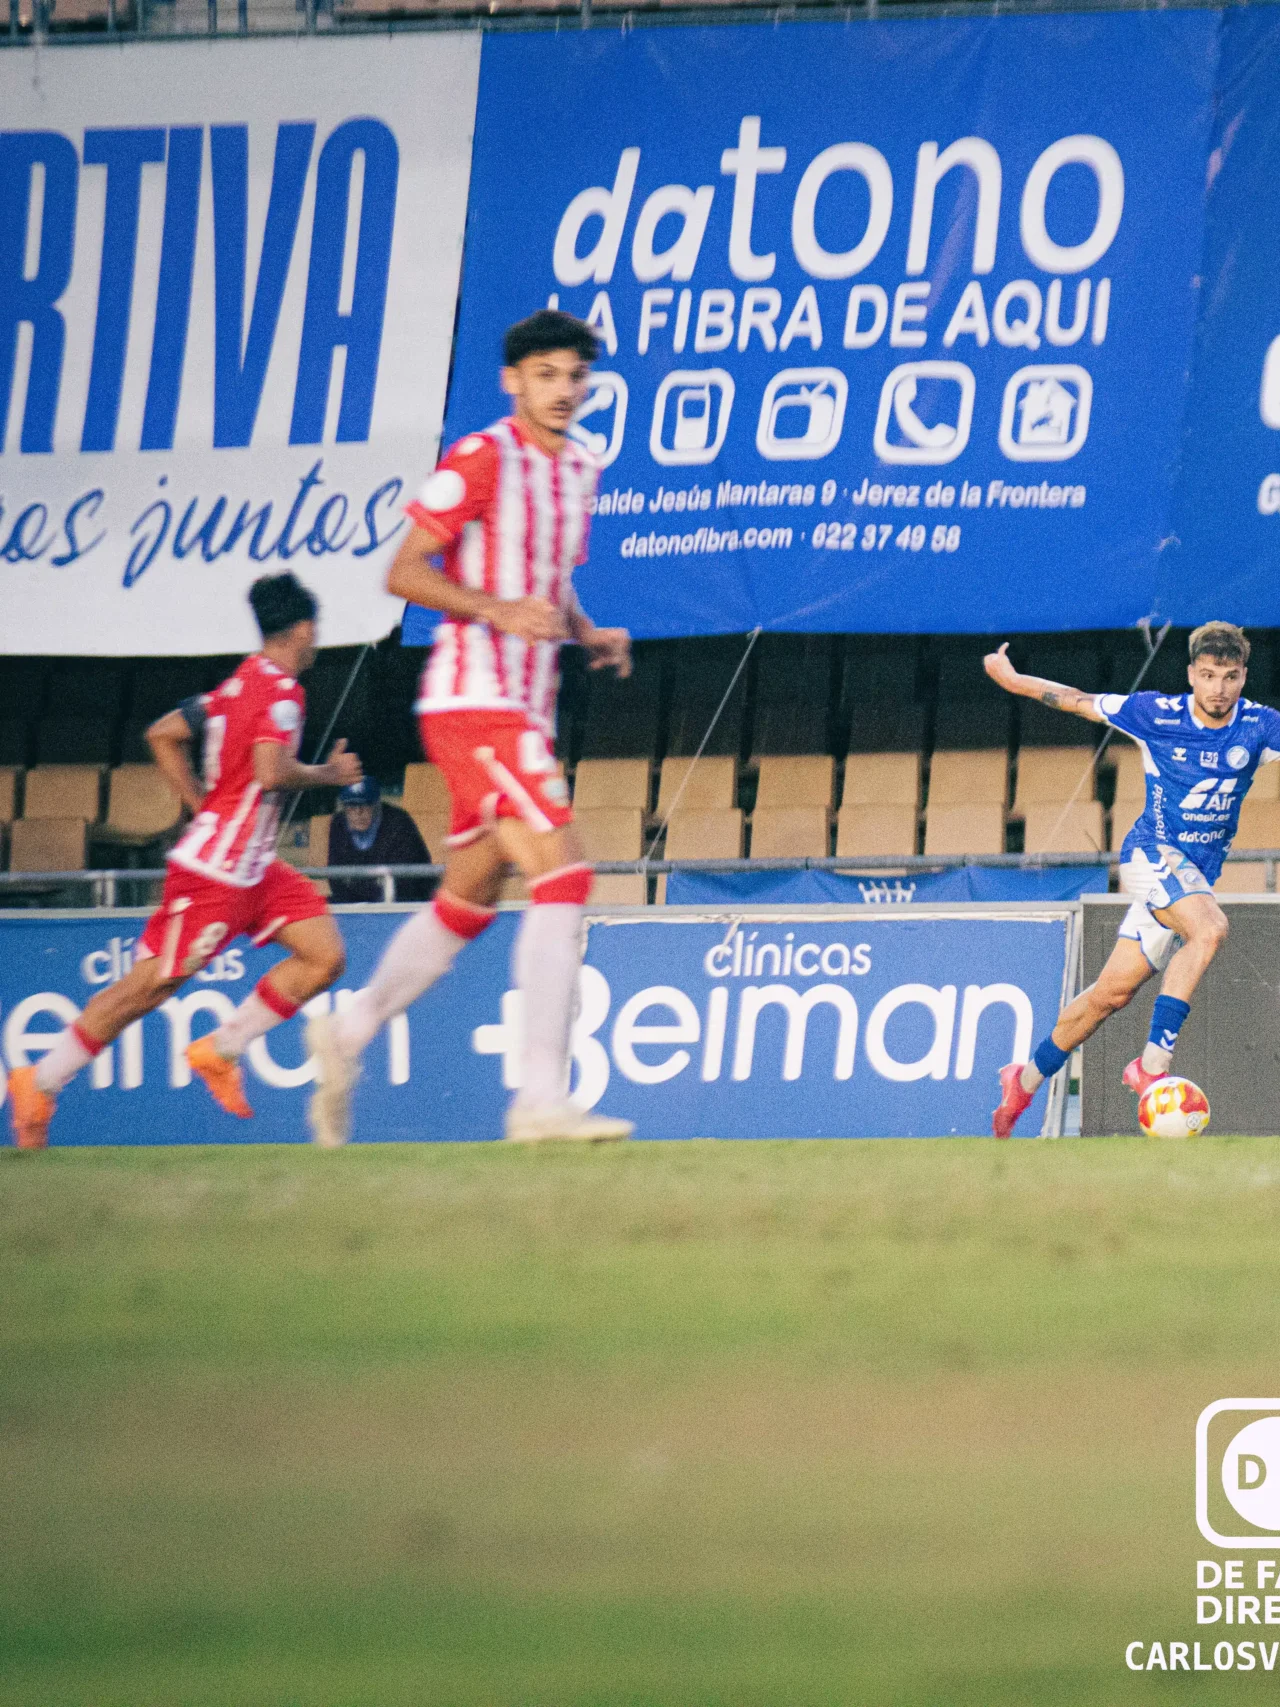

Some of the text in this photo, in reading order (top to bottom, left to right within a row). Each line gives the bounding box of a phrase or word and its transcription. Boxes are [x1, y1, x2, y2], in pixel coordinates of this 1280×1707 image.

[552, 116, 1124, 287] datono
[638, 284, 824, 355] FIBRA
[843, 281, 932, 350] DE
[943, 278, 1111, 351] AQUI
[649, 484, 712, 514] Jesús
[715, 479, 816, 510] Mantaras
[820, 479, 838, 507] 9
[852, 477, 921, 508] Jerez
[925, 480, 956, 508] de
[959, 479, 982, 508] la
[985, 479, 1087, 509] Frontera
[121, 457, 407, 588] juntos
[620, 526, 793, 559] datonofibra.com
[811, 522, 858, 551] 622
[861, 524, 893, 551] 37
[1205, 794, 1236, 811] Air
[705, 931, 872, 979] clínicas
